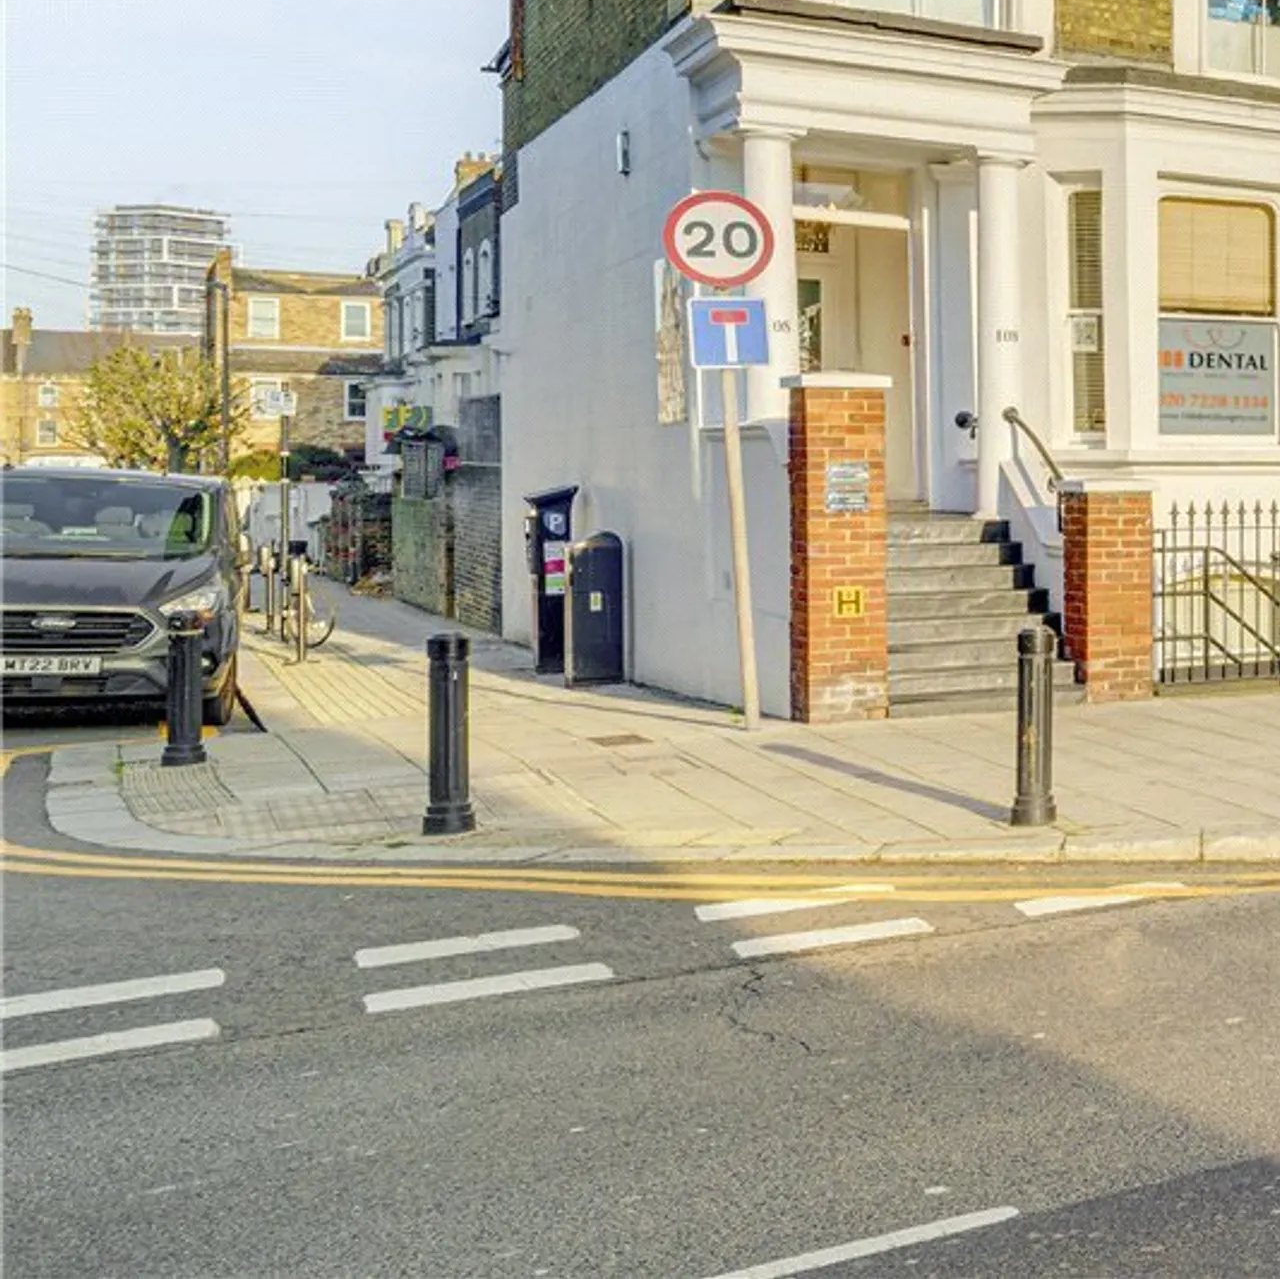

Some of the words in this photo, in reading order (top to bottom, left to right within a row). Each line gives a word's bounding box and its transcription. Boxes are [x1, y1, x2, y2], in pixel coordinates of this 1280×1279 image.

[683, 221, 757, 258] 20
[1189, 351, 1268, 371] DENTAL
[550, 513, 562, 533] P
[837, 591, 861, 615] H
